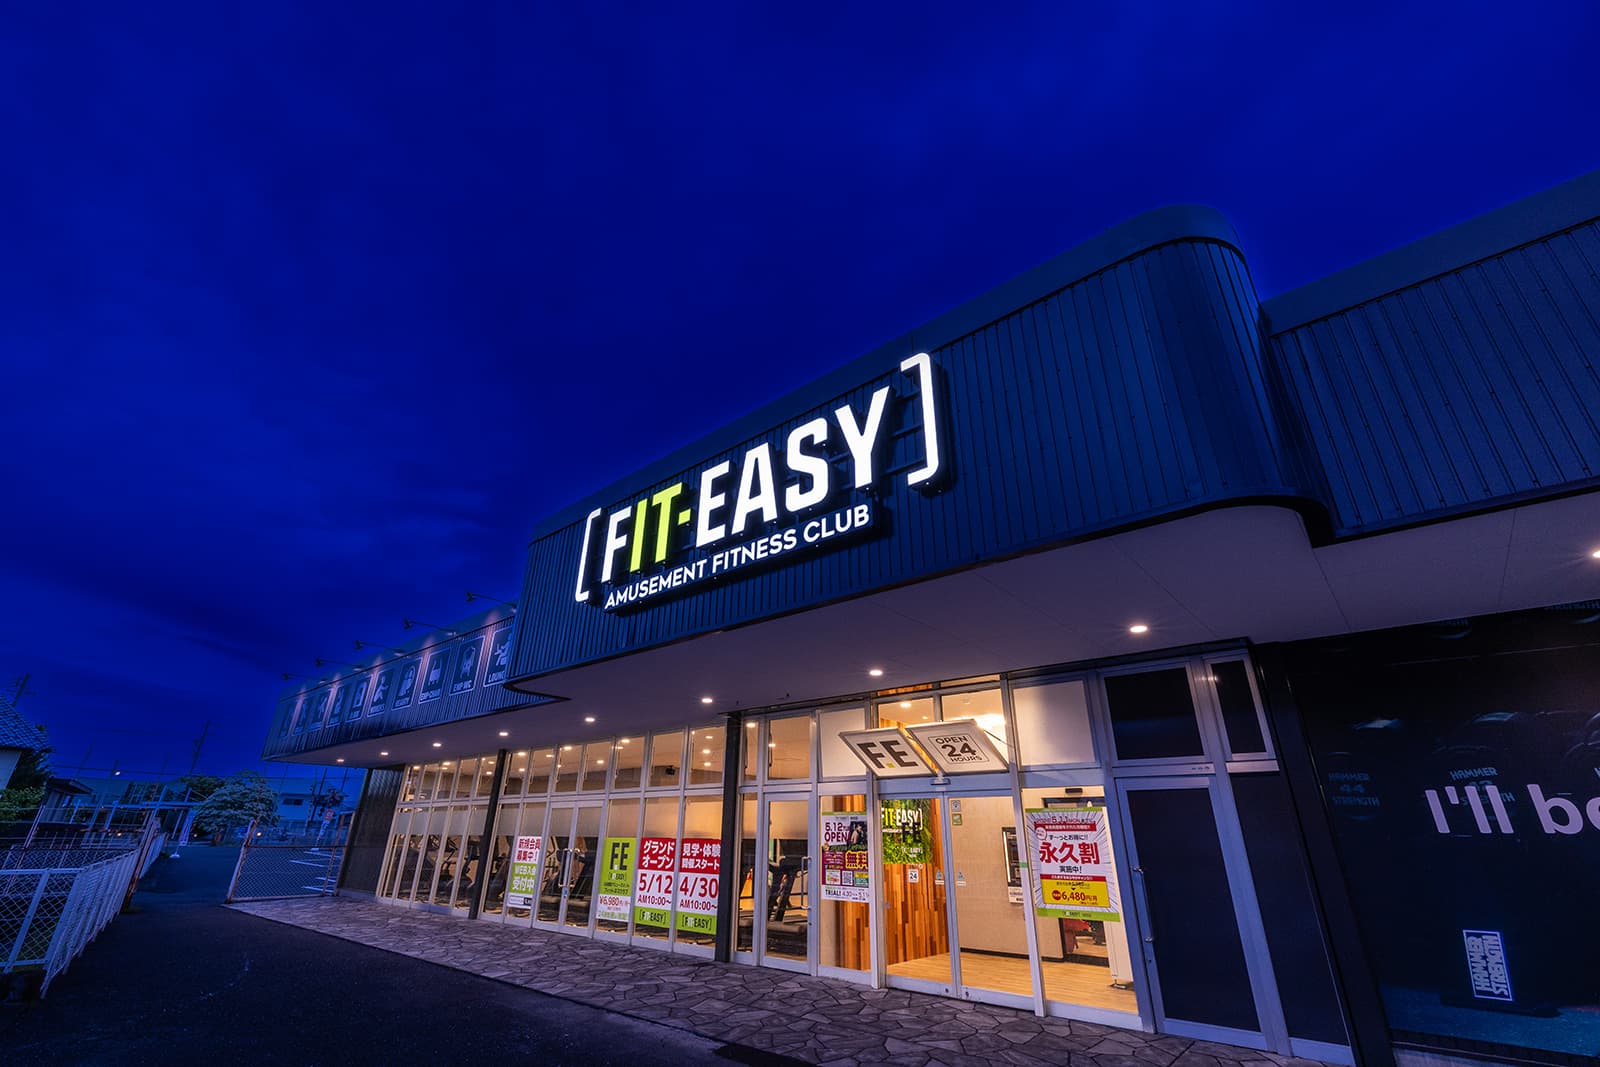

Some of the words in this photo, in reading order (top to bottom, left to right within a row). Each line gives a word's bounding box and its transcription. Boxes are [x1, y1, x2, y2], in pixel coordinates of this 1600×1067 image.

[604, 559, 708, 609] AMUSEMENT
[712, 528, 797, 575] FITNESS
[803, 504, 870, 543] CLUB
[935, 735, 969, 745] OPEN
[941, 743, 977, 758] 24
[950, 755, 983, 763] HOURS
[1425, 785, 1515, 834] I'll
[643, 840, 675, 855] グランド
[1039, 841, 1100, 865] 永久割
[642, 854, 674, 869] オープン
[639, 873, 673, 894] 5/12
[679, 876, 719, 898] 4/30
[1467, 936, 1494, 992] HAMMER
[1482, 935, 1508, 996] STRENGTH
